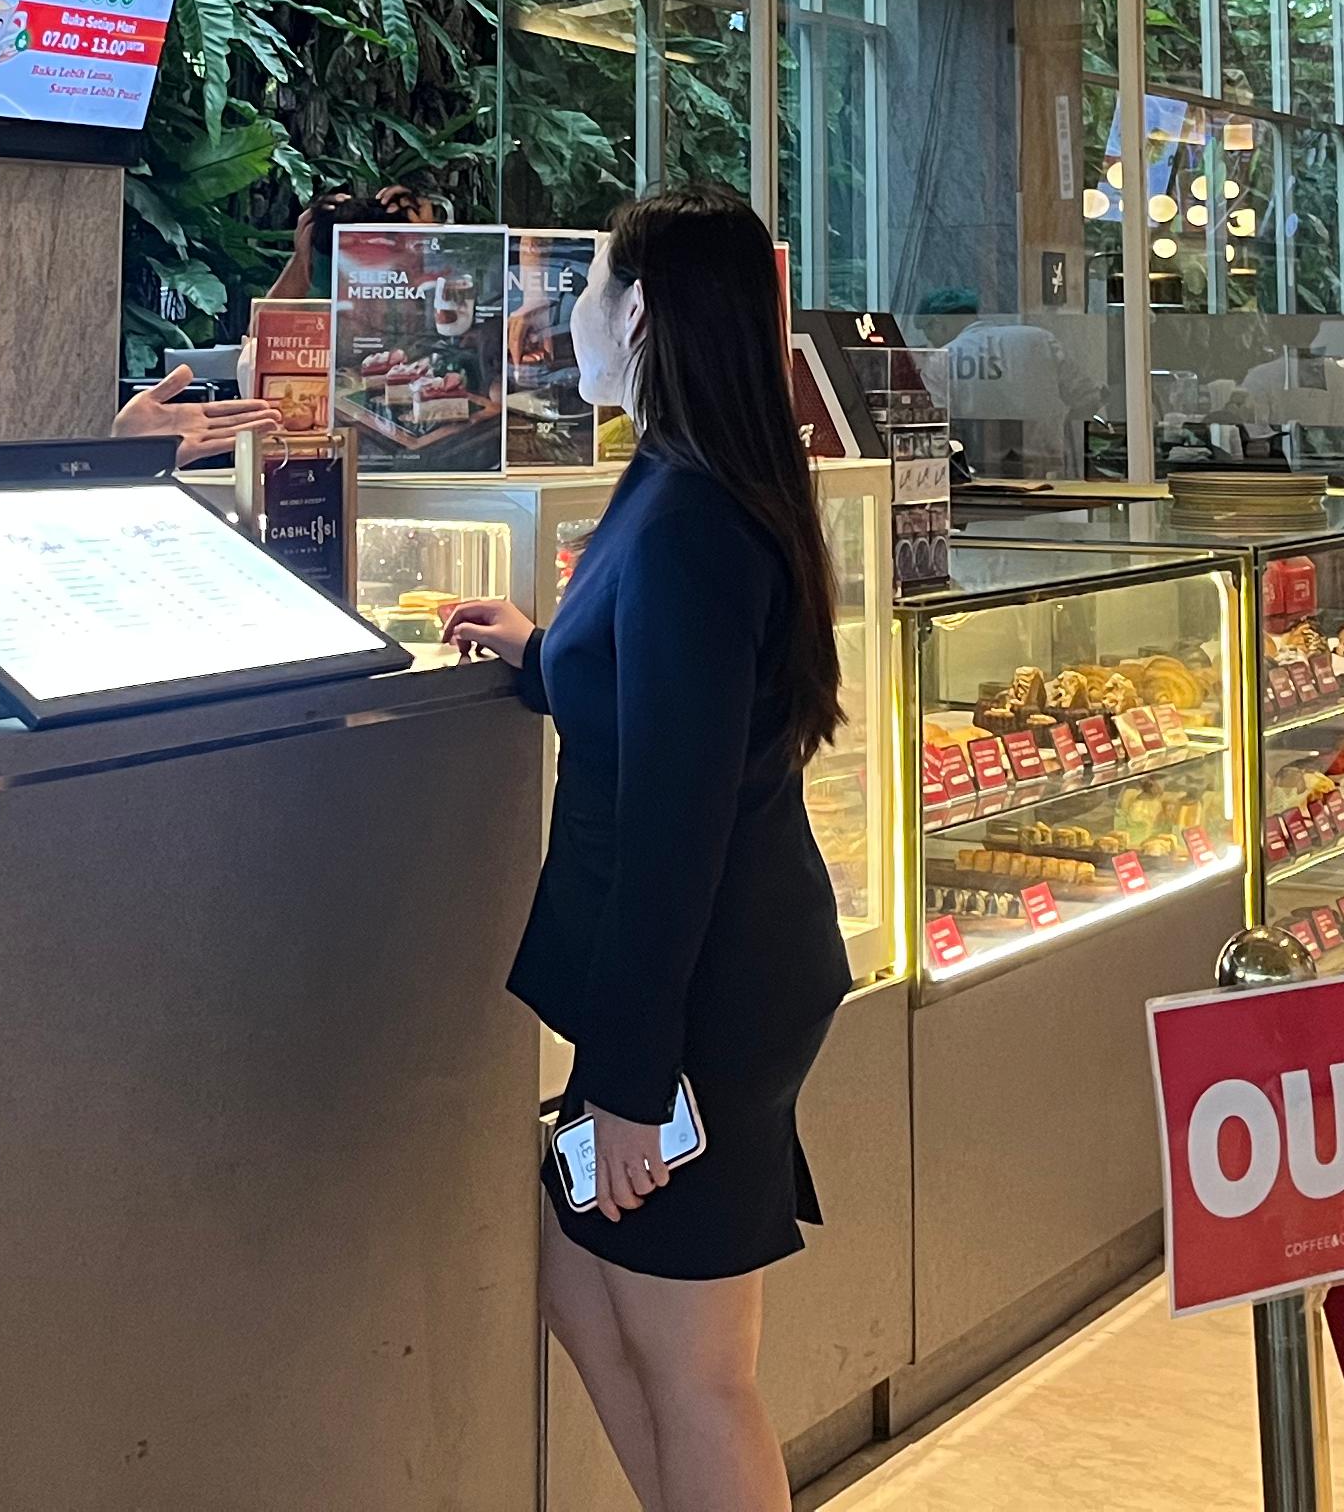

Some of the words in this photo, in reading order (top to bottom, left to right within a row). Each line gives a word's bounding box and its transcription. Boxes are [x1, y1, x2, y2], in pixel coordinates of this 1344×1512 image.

[61, 11, 86, 27] Buka
[86, 15, 115, 34] Setiap
[116, 20, 137, 34] Hari
[42, 30, 80, 50] 07.00
[91, 37, 126, 56] 13.00
[31, 64, 57, 77] Buka
[58, 67, 86, 79] Lebih
[49, 83, 89, 97] Sarapan
[90, 86, 115, 98] Lebih
[348, 270, 409, 284] SELERA
[348, 286, 426, 300] MERDEKA
[949, 346, 1002, 380] ibis
